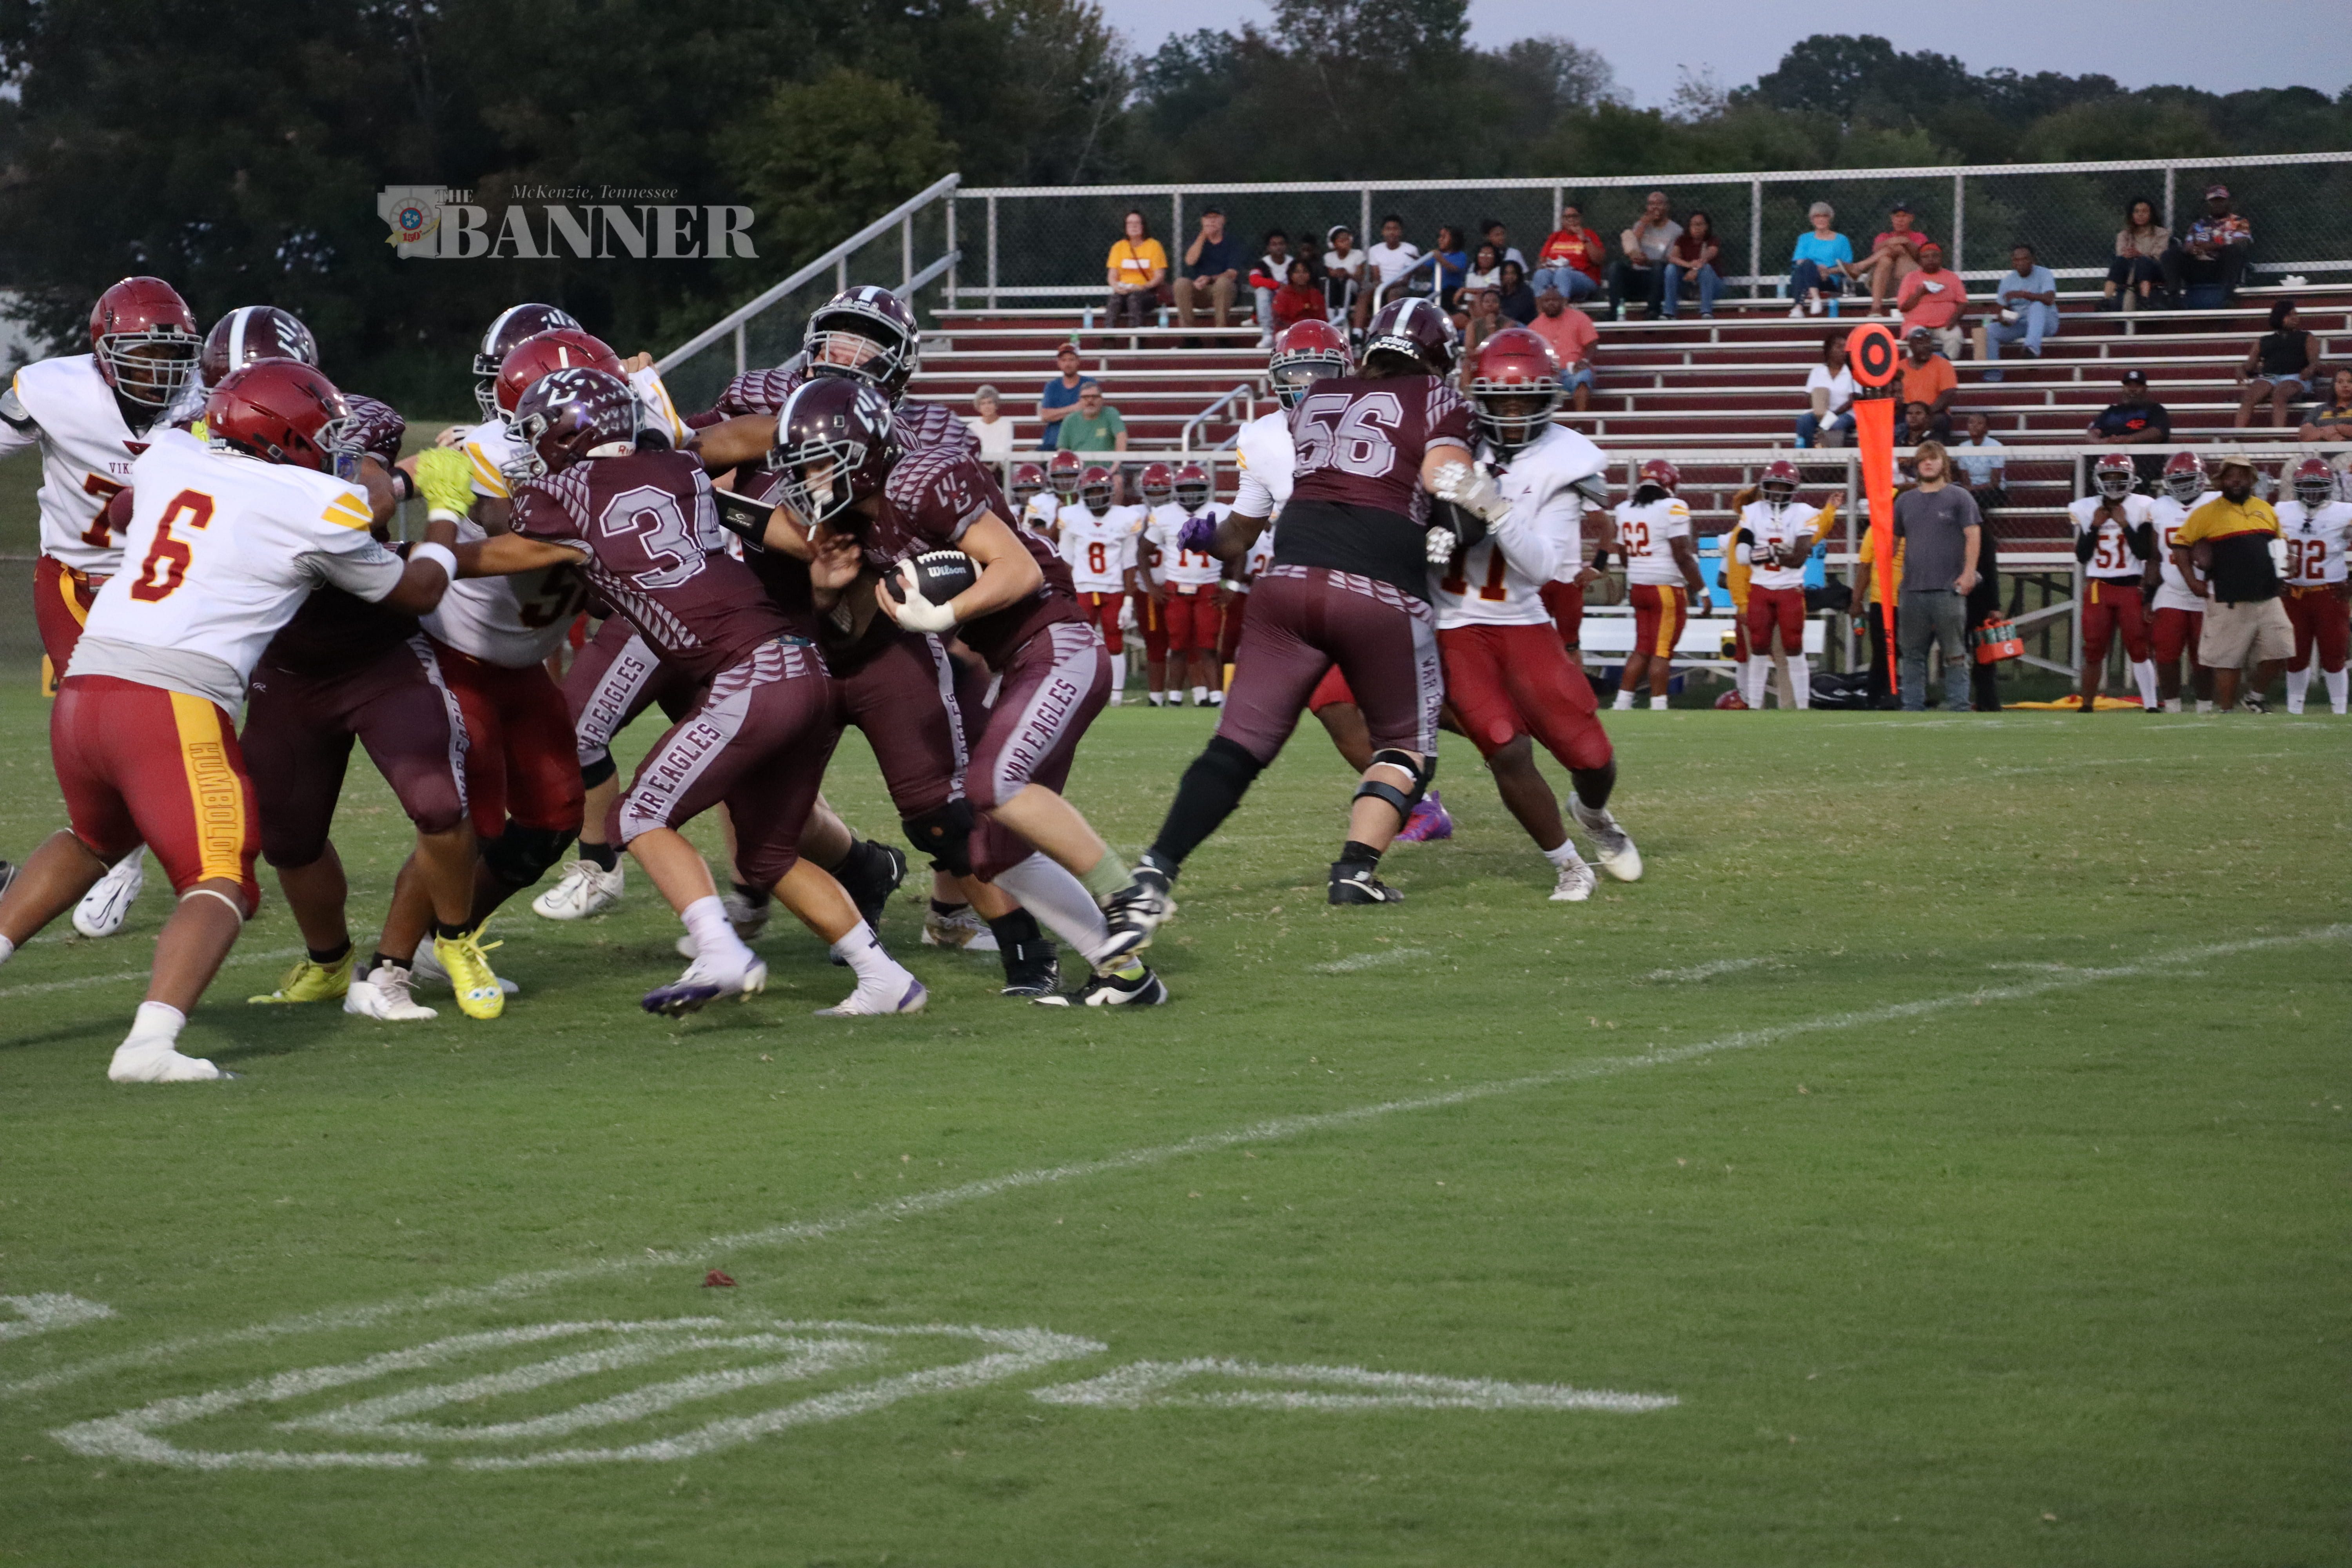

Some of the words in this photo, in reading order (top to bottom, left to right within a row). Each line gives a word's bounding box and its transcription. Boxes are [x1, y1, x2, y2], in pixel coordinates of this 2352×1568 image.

[1380, 336, 1413, 349] schutt
[1293, 391, 1404, 477] 56
[109, 462, 132, 474] VIK
[130, 488, 214, 603] 6
[1089, 541, 1107, 574] 8
[1622, 521, 1652, 557] 62
[2095, 534, 2127, 569] 51
[927, 565, 967, 577] Wilson
[591, 655, 647, 726] EAGLES
[1021, 678, 1078, 751] EAGLES
[648, 722, 722, 795] EAGLES
[189, 742, 238, 865] HUMBOLDT
